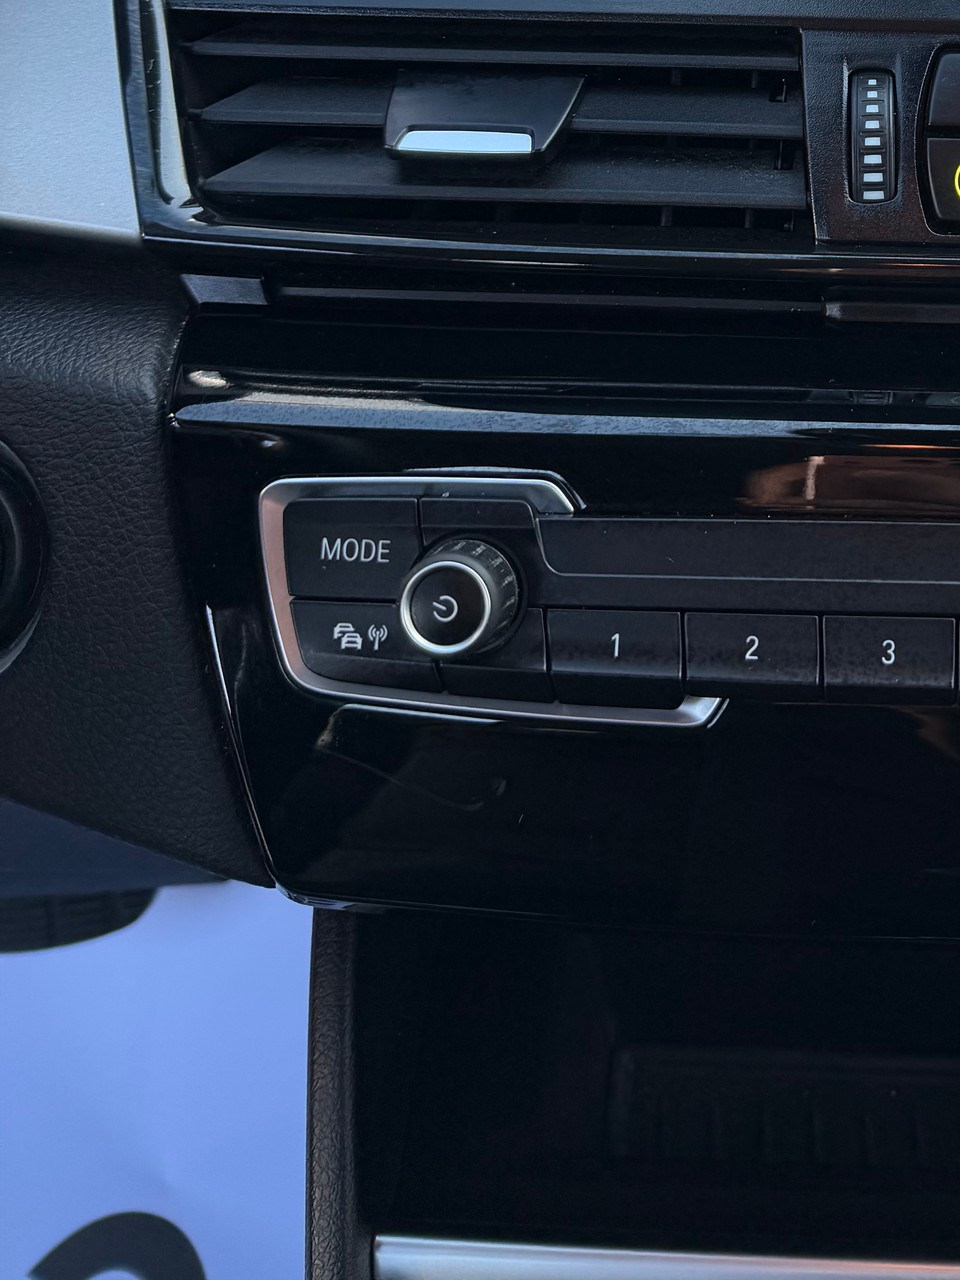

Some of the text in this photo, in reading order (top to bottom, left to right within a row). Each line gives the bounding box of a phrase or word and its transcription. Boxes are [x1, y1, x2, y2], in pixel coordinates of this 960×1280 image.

[320, 538, 391, 564] MODE
[611, 633, 621, 658] 1
[745, 636, 760, 661] 2
[881, 640, 896, 665] 3
